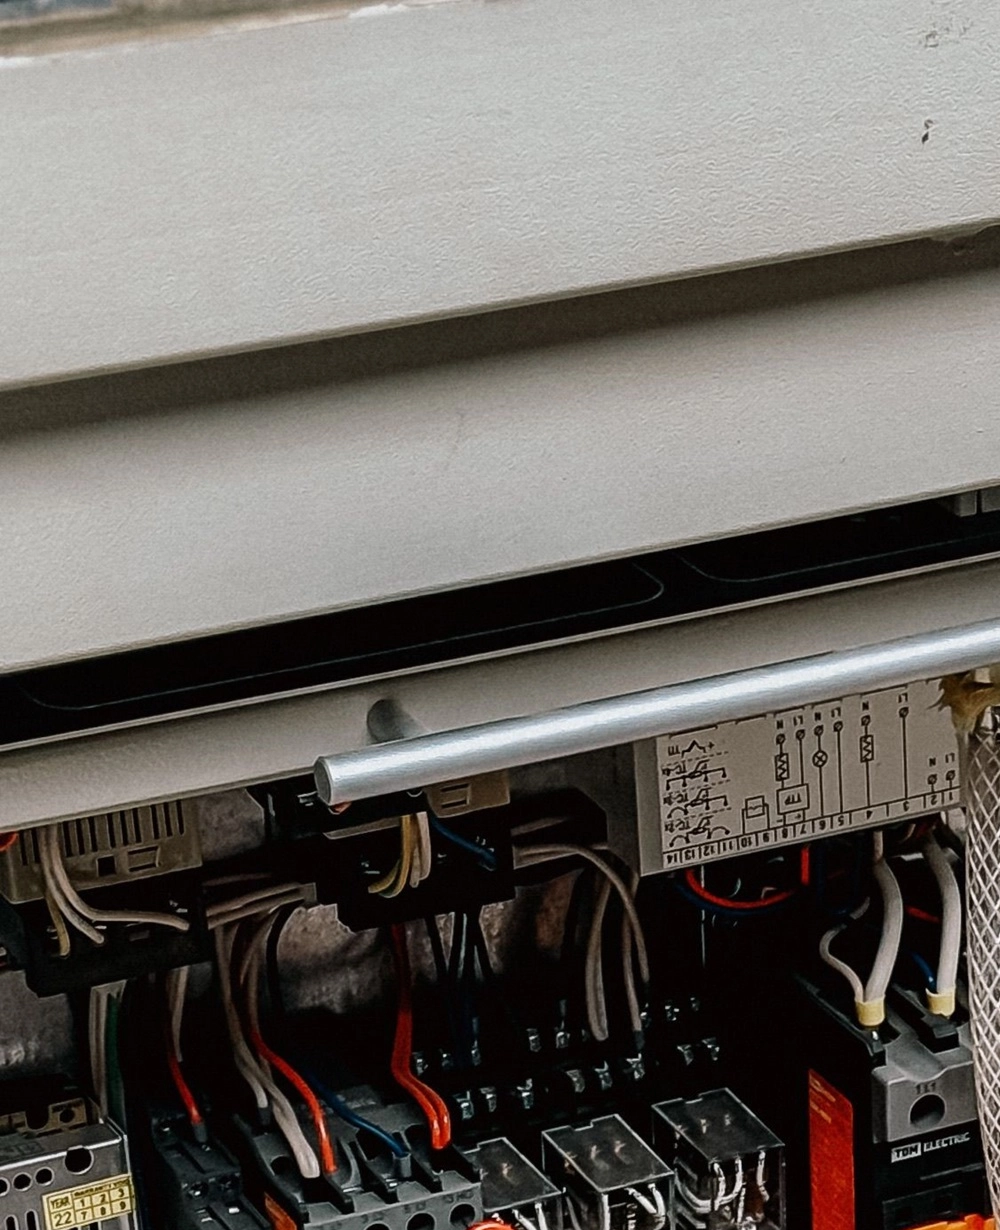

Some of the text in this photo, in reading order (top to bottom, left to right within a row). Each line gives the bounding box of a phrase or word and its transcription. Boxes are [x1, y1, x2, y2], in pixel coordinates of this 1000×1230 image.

[862, 692, 908, 711] L1 N
[776, 706, 842, 730] N L1 N L1
[929, 758, 936, 767] N
[903, 800, 910, 812] 3
[930, 794, 938, 806] 2
[838, 815, 844, 826] 5
[866, 810, 873, 820] 4
[800, 823, 807, 835] 7
[819, 820, 826, 830] 6
[762, 832, 770, 843] 9
[781, 827, 788, 839] 8
[722, 841, 733, 852] 11
[741, 836, 752, 848] 10
[684, 849, 696, 860] 13
[703, 845, 715, 857] 12
[667, 853, 678, 864] 14
[891, 1131, 971, 1163] TDM ELECTRIC
[51, 1196, 71, 1209] YEAR
[54, 1211, 73, 1228] 22
